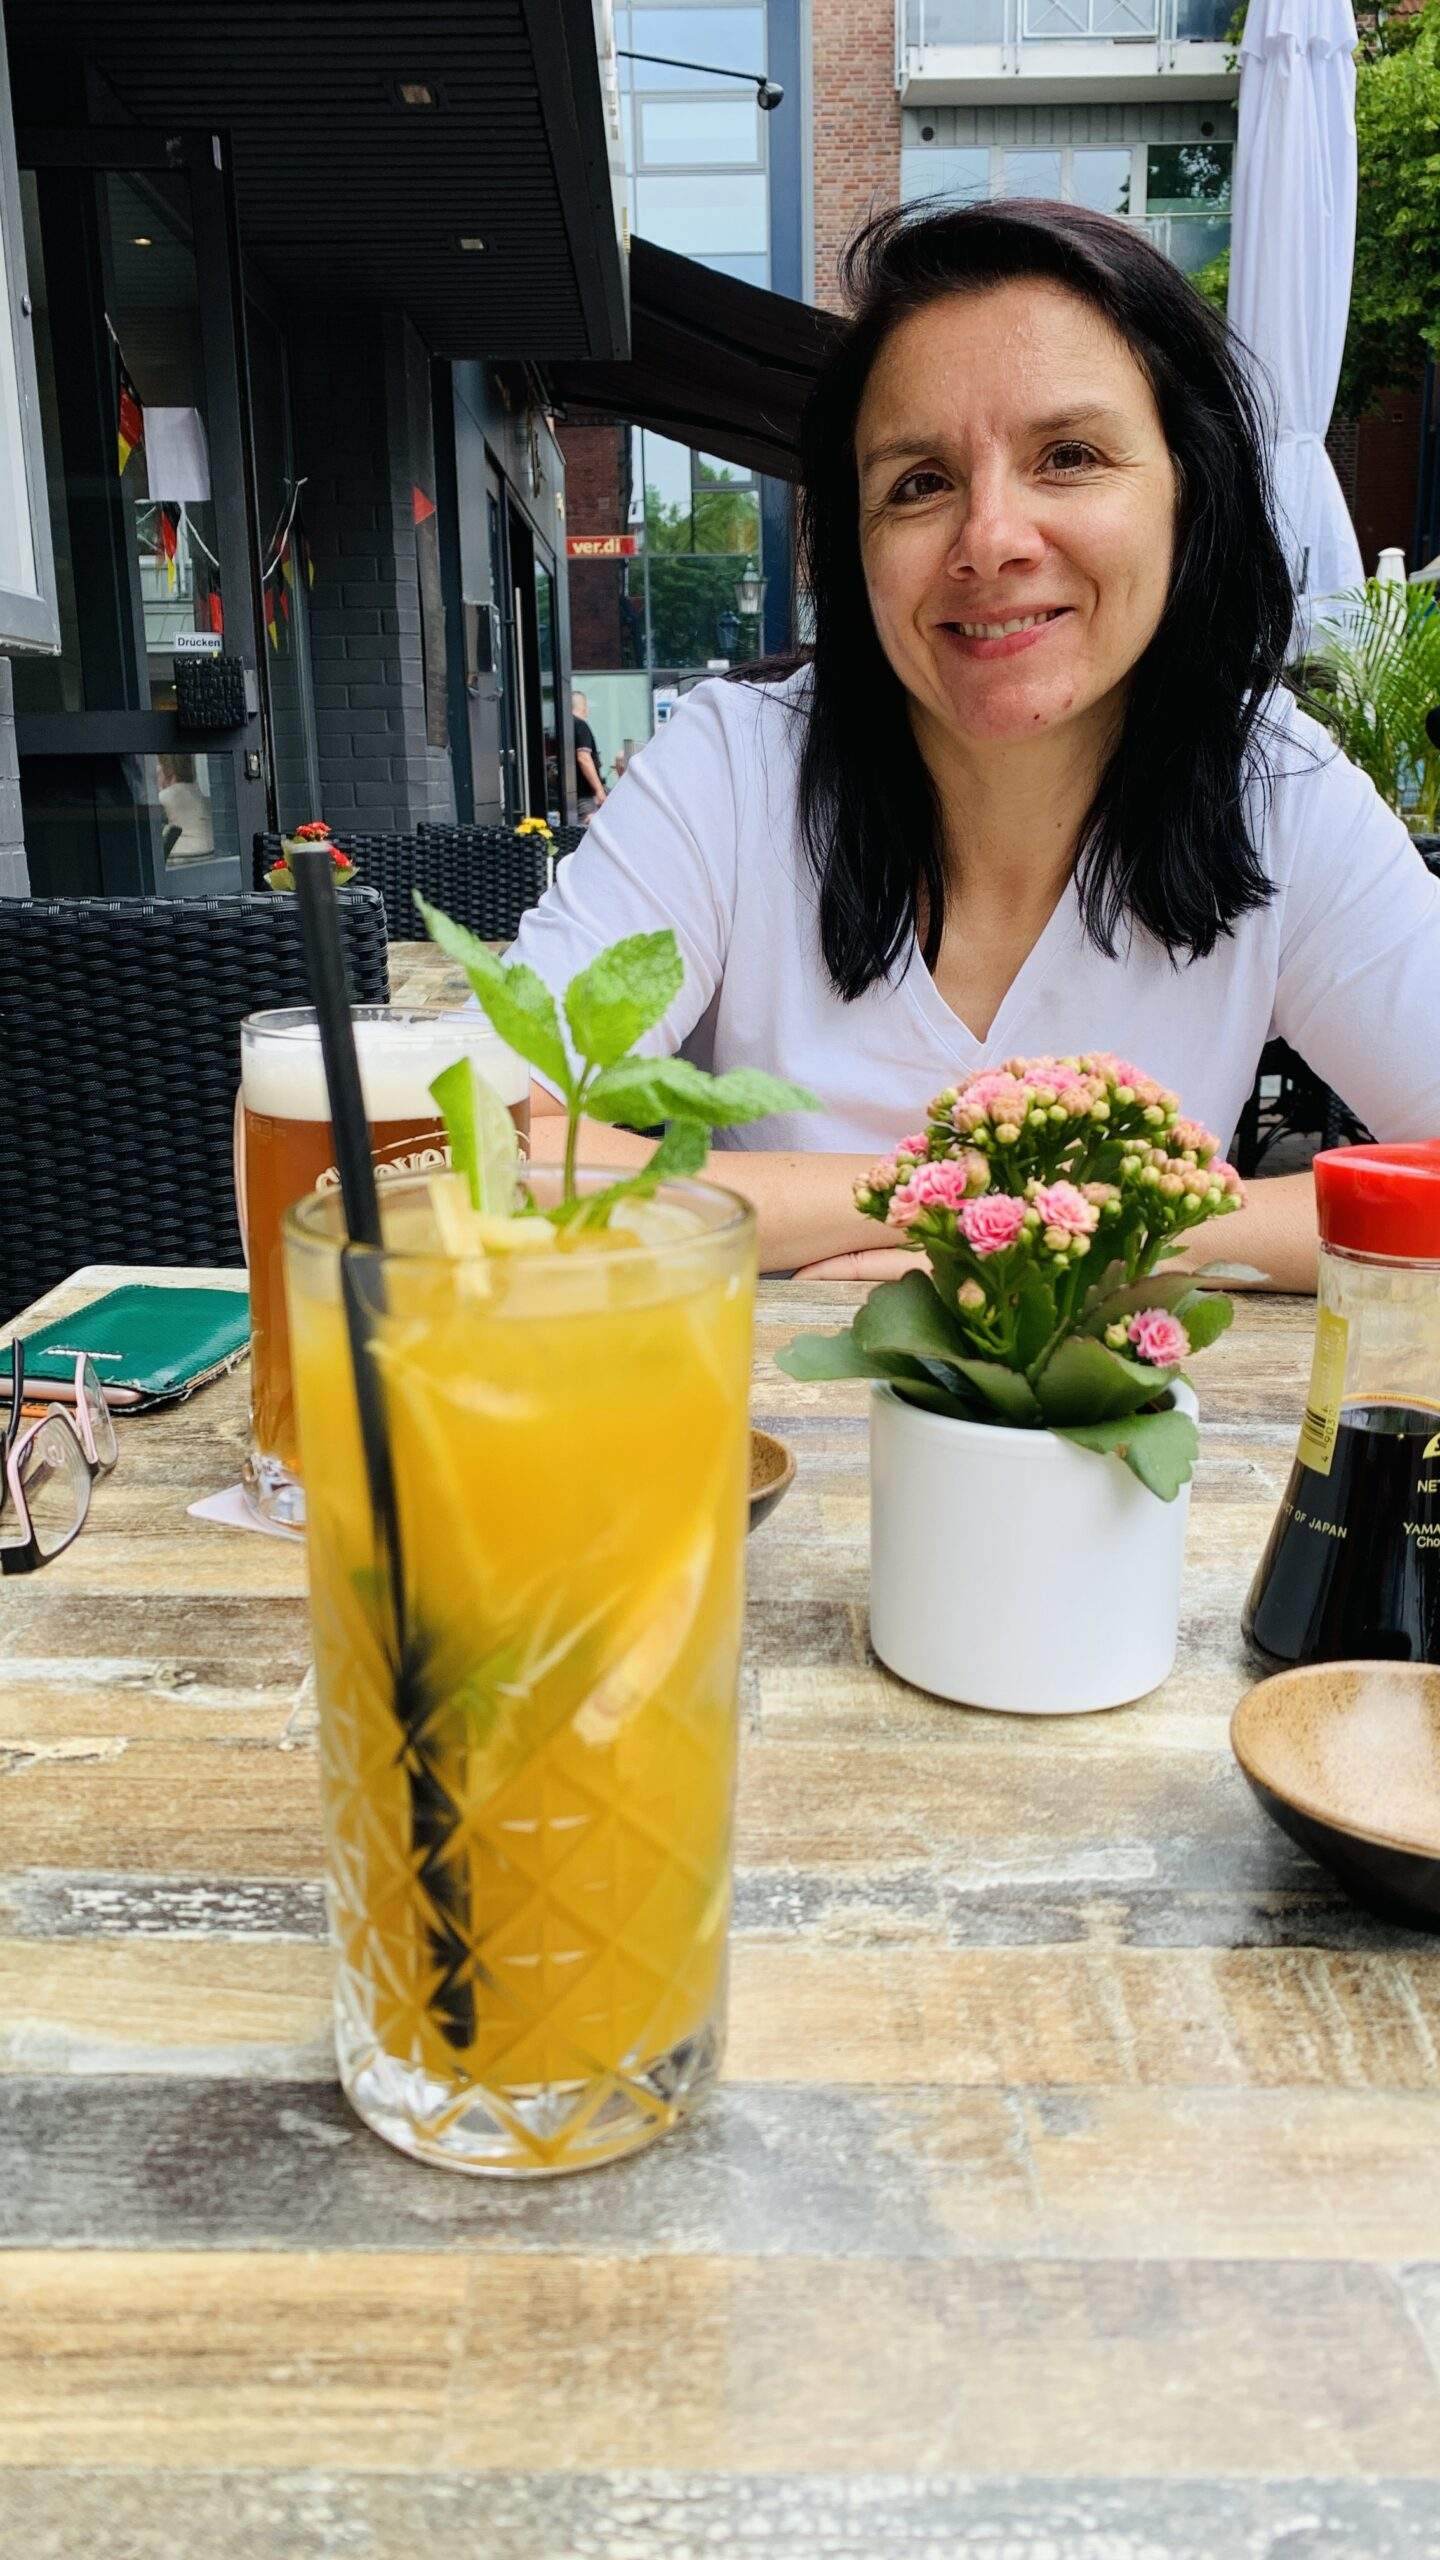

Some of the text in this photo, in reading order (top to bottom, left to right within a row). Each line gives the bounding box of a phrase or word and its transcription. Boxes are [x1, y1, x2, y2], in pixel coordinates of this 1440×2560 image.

[572, 538, 621, 554] ver.di
[177, 636, 221, 647] Drücken
[1294, 1510, 1307, 1523] OF
[1308, 1517, 1348, 1539] JAPAN
[1403, 1522, 1440, 1535] YAMA
[1416, 1536, 1440, 1549] Cho
